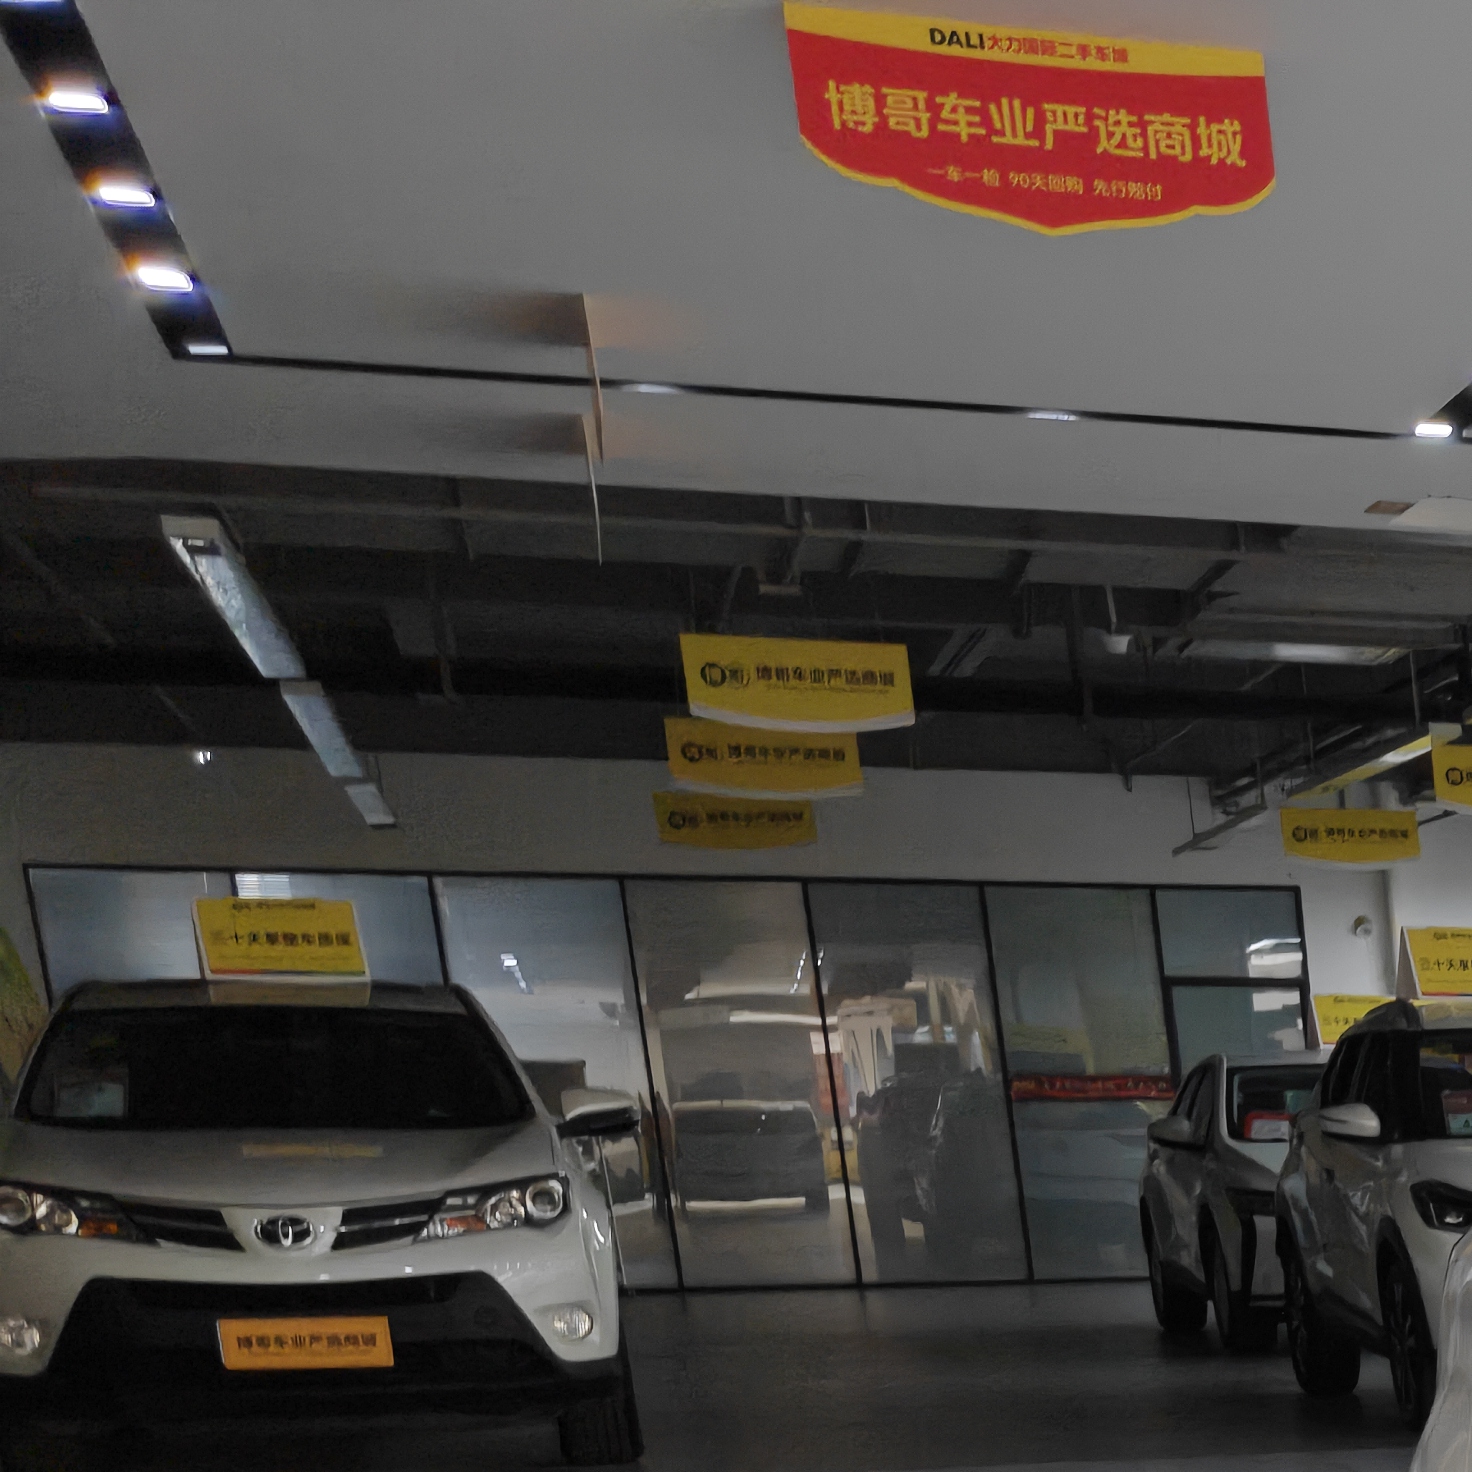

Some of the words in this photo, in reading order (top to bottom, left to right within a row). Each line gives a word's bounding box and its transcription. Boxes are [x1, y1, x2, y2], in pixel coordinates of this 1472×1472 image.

[929, 27, 985, 50] DALI
[824, 79, 1247, 168] 博哥车业严选商城
